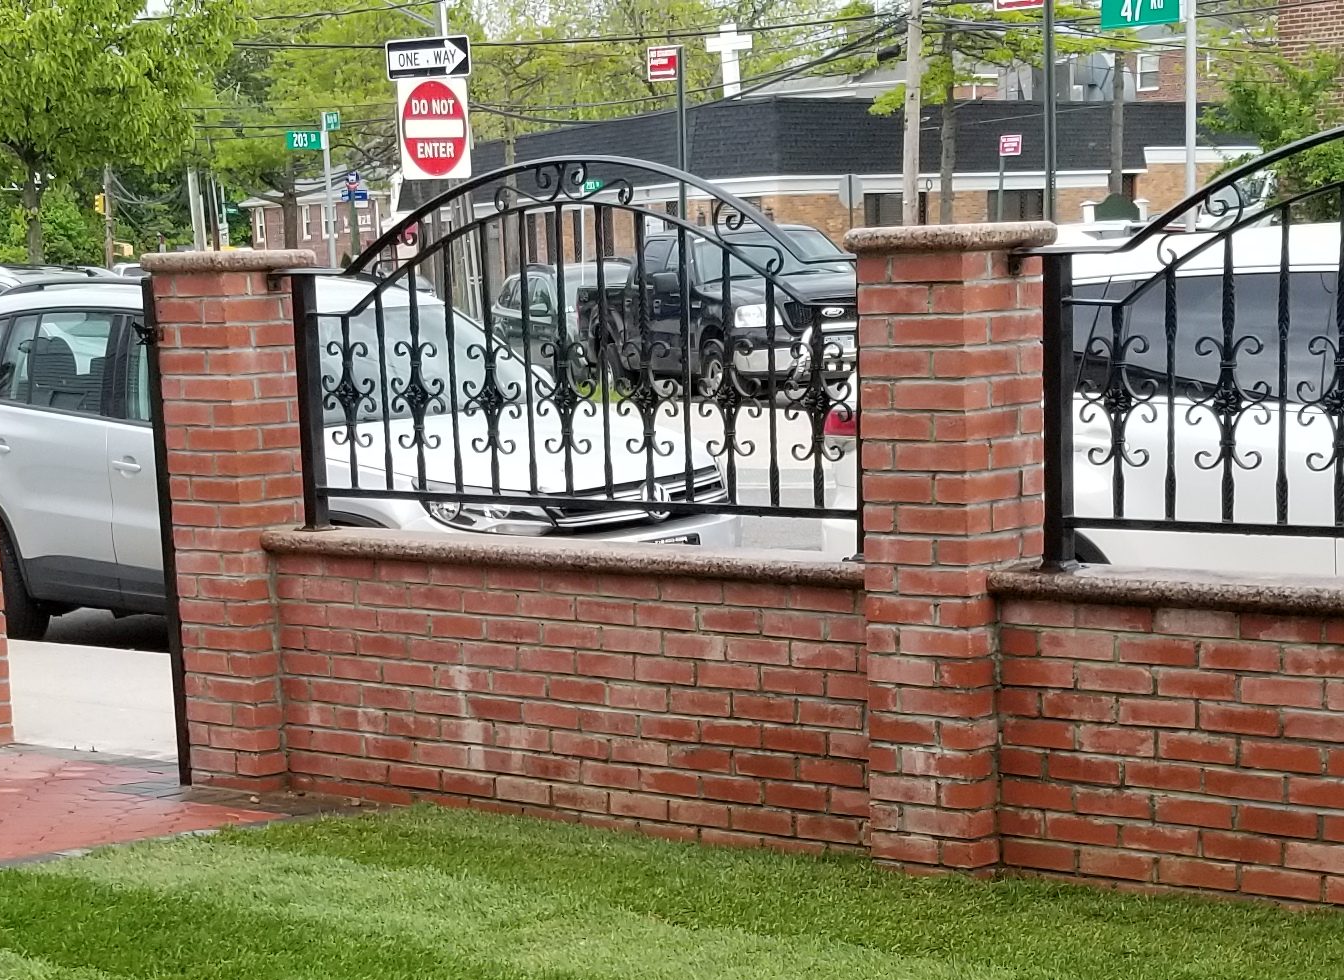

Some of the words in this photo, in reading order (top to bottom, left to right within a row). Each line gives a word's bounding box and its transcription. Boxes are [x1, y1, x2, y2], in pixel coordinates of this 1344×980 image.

[398, 52, 420, 67] ONE
[433, 49, 457, 65] WAY
[411, 99, 428, 115] DO
[432, 99, 455, 115] NOT
[292, 133, 308, 148] 203
[417, 142, 454, 159] ENTER
